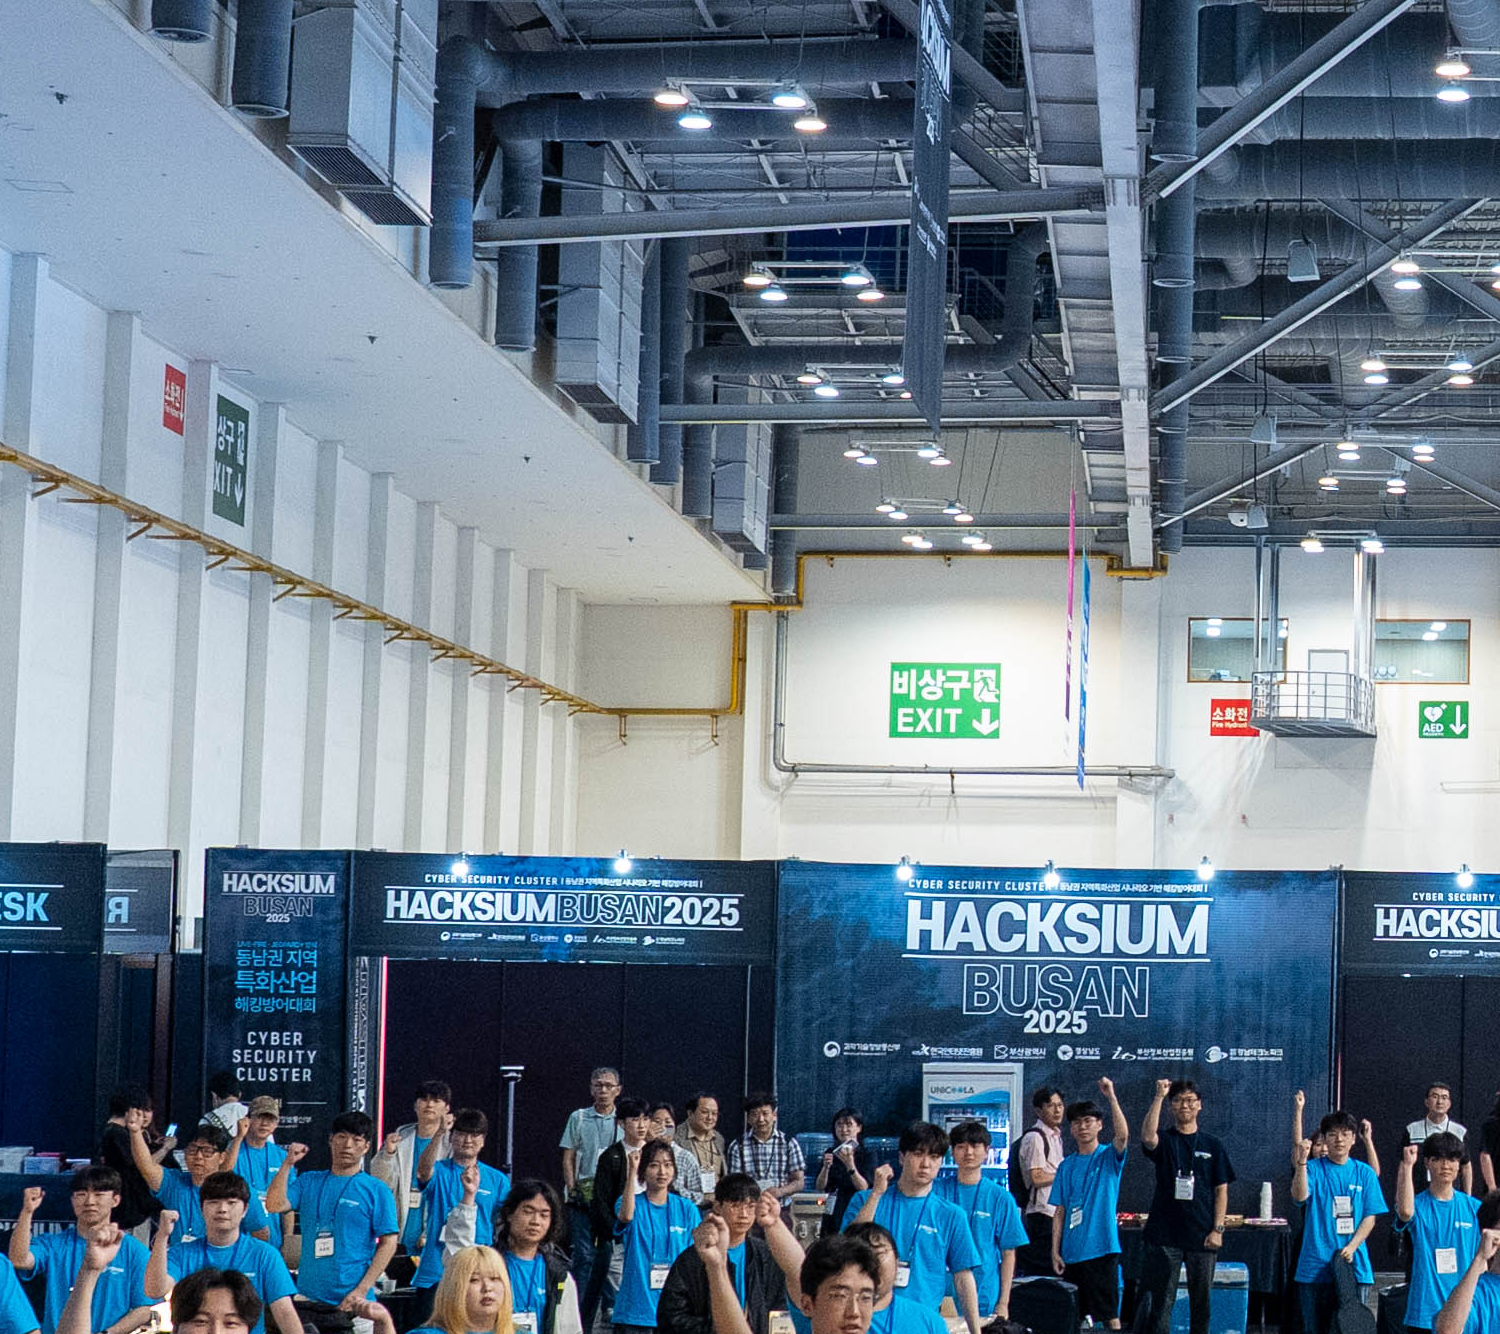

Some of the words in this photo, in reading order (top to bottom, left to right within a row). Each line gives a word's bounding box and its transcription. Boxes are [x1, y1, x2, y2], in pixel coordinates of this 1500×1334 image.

[213, 460, 233, 497] XIT
[892, 667, 972, 701] 비상구
[897, 708, 958, 733] EXIT
[1212, 707, 1248, 721] 소화전
[1423, 724, 1444, 733] AED
[222, 873, 336, 894] HACKSIUM
[425, 874, 458, 884] CYBER
[461, 875, 510, 885] SECURITY
[514, 876, 558, 886] CLUSTER
[908, 879, 943, 889] CYBER
[947, 880, 1000, 891] SECURITY
[1412, 892, 1443, 902] CYBER
[1448, 893, 1495, 902] SECURITY
[244, 896, 313, 916] BUSAN
[266, 913, 290, 923] 2025
[906, 899, 1209, 955] HACKSIUM
[236, 949, 283, 967] 동남권
[286, 949, 317, 967] 지역
[235, 970, 317, 994] 특화산업
[963, 964, 1149, 1017] BUSAN
[234, 996, 317, 1013] 해킹방어대회
[1023, 1010, 1088, 1035] 2025
[247, 1031, 303, 1046] CYBER
[232, 1049, 317, 1064] SECURITY
[236, 1067, 312, 1082] CLUSTER
